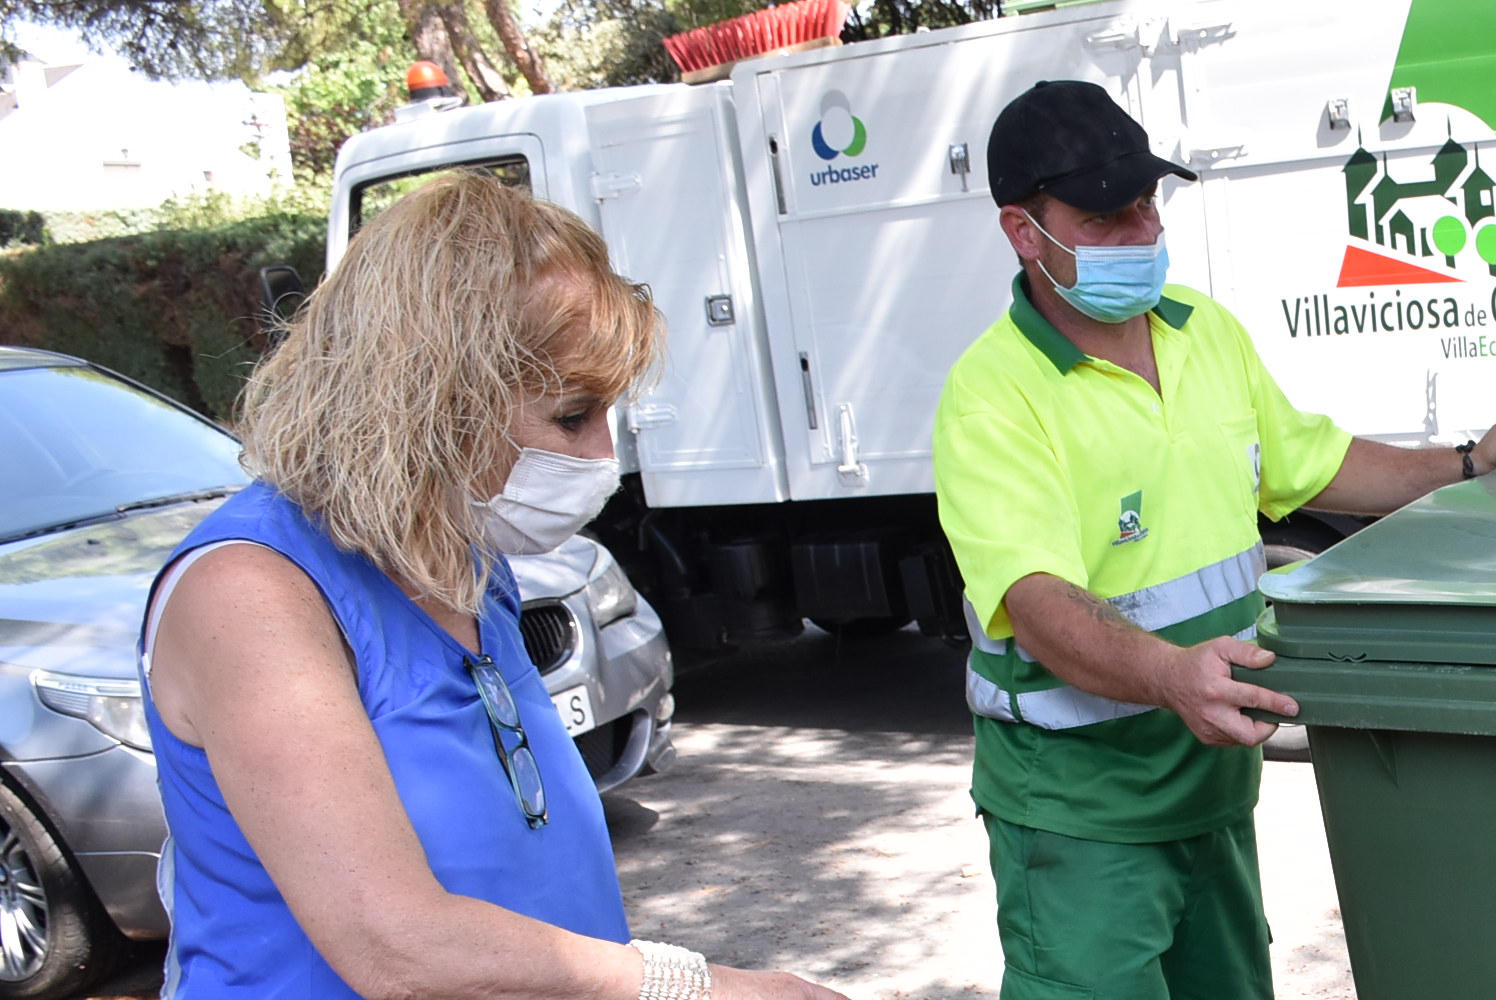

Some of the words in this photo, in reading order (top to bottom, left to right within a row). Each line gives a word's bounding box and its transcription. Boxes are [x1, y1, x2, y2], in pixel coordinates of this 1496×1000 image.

[810, 164, 879, 186] urbaser
[1281, 289, 1460, 338] Villaviciosa
[1464, 304, 1487, 327] de
